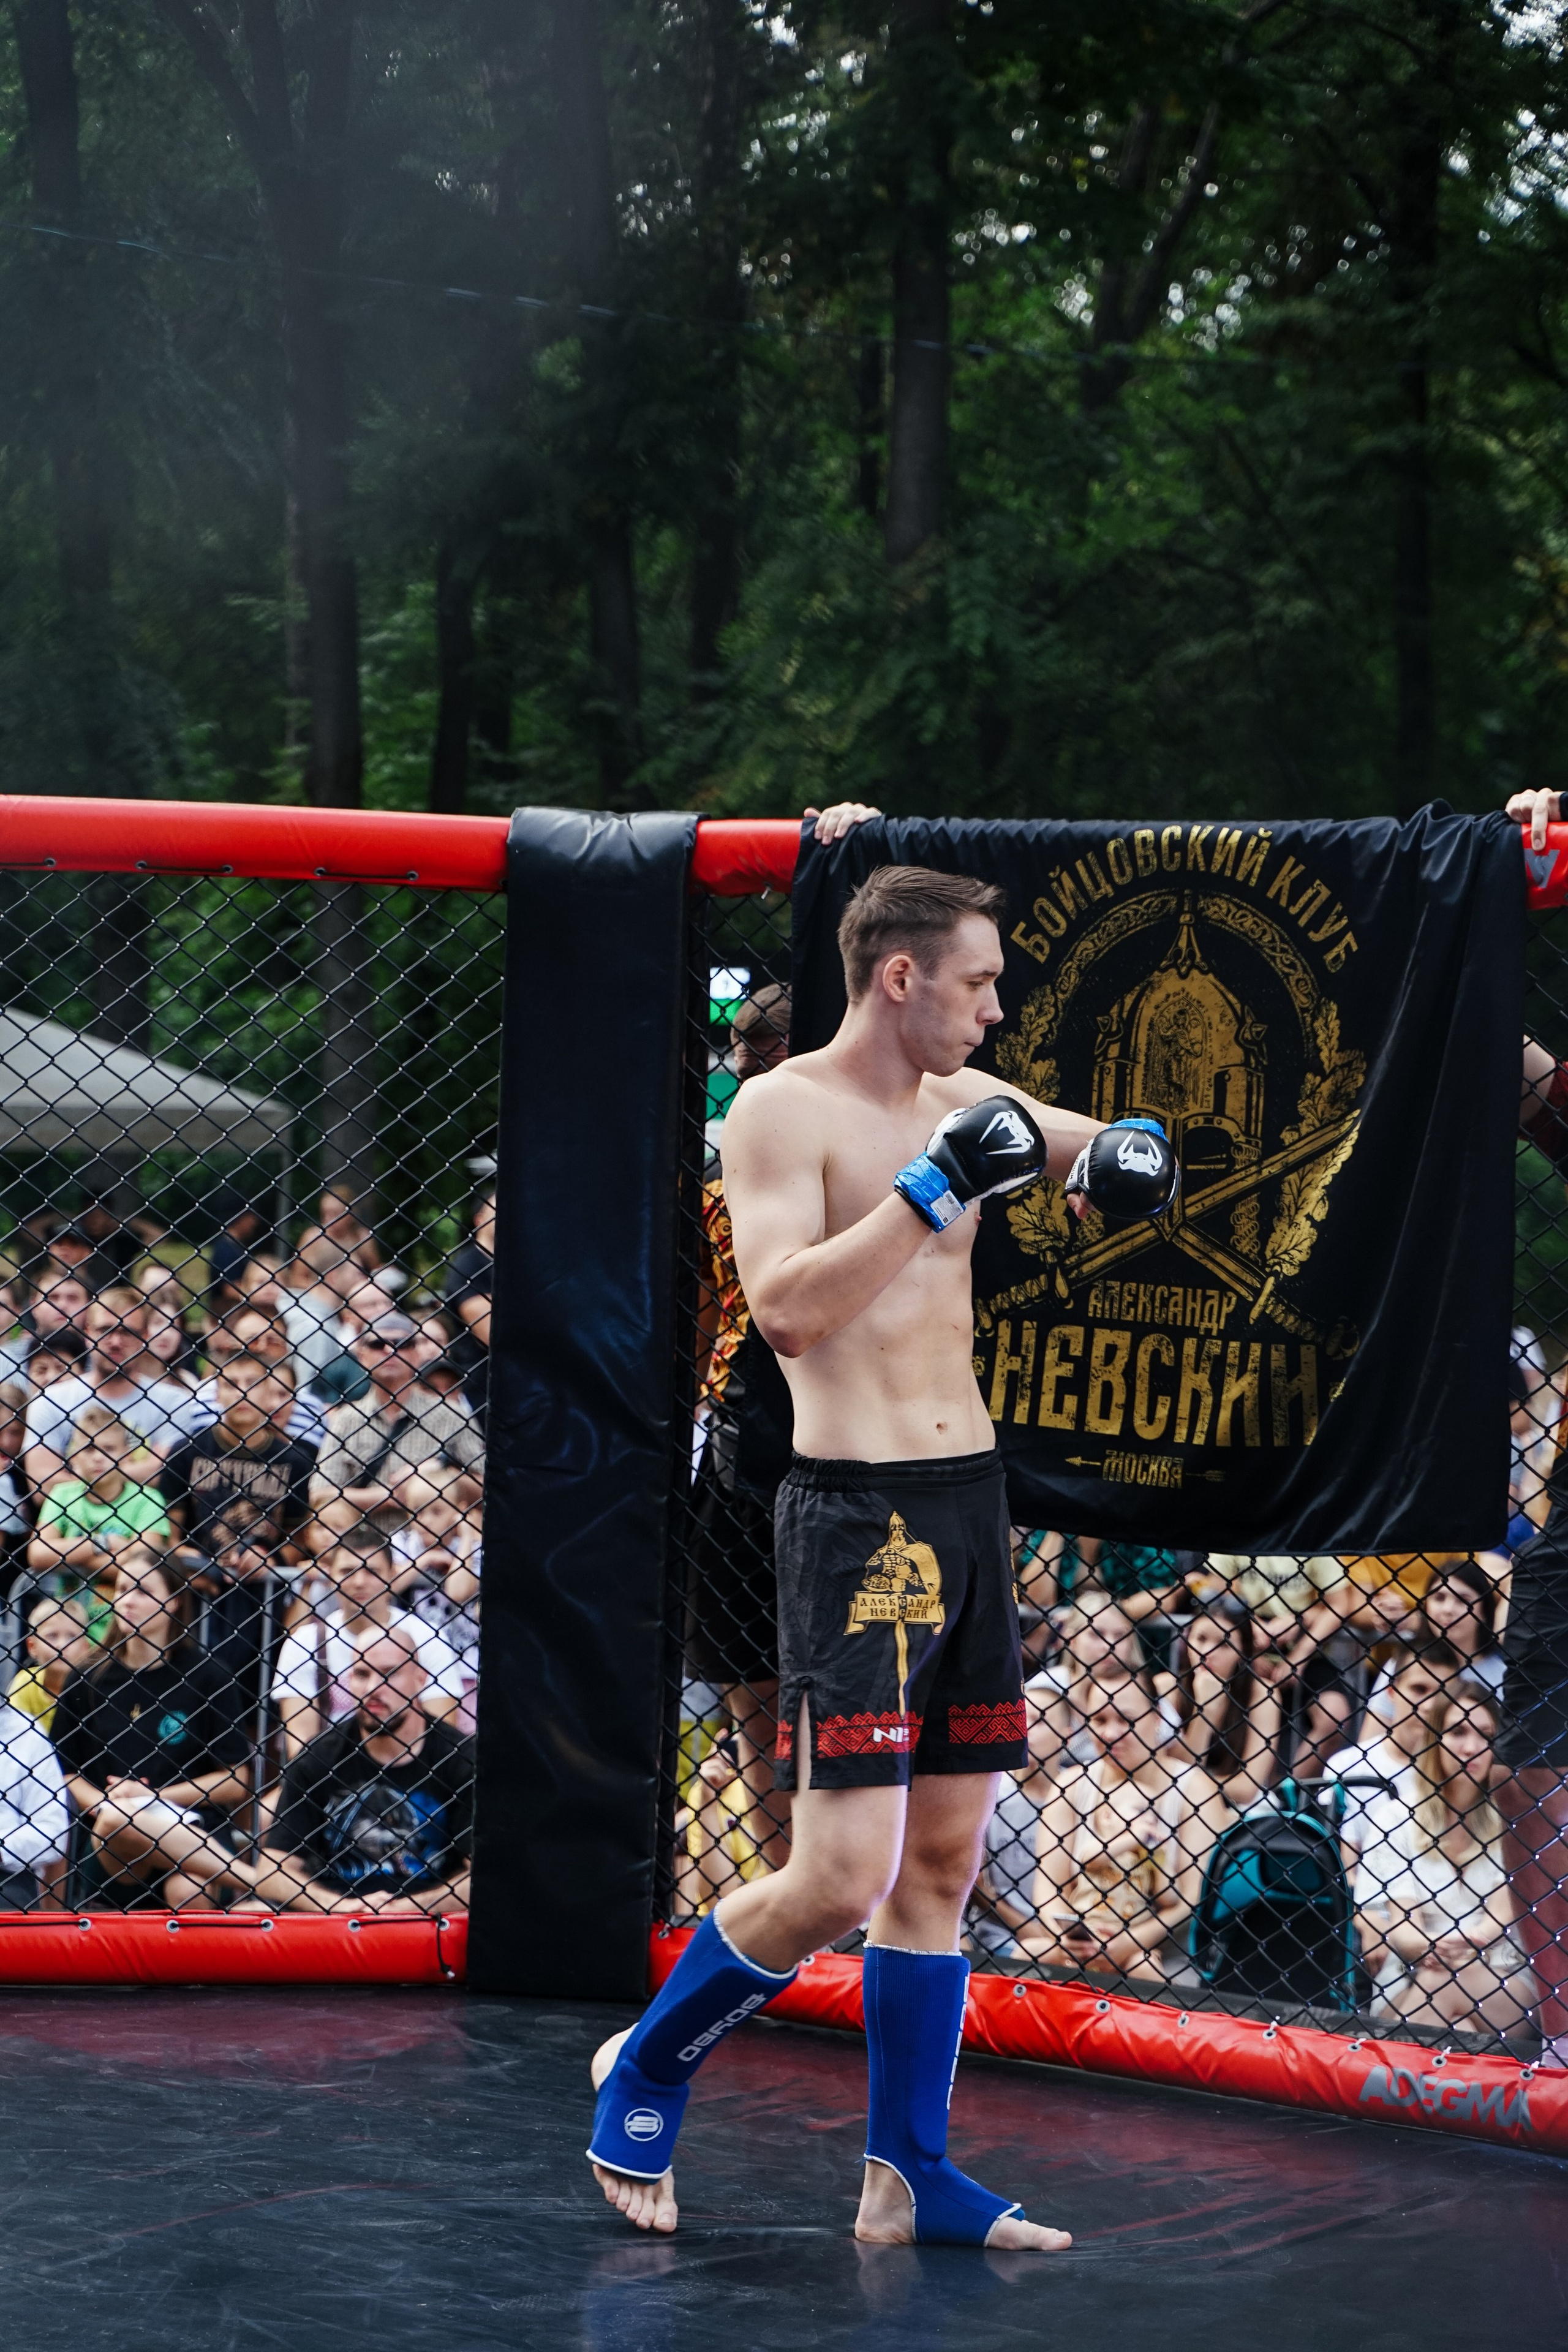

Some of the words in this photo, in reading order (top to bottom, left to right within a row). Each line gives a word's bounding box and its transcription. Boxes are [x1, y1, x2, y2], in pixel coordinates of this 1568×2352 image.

[1010, 824, 1273, 963] БОЙЦОВСКИЙ
[1265, 855, 1359, 973] КЛУБ
[1088, 1280, 1237, 1336] АЛЕКСАНДР
[1102, 1449, 1184, 1489] МОСКВА
[860, 1597, 936, 1608] АЛЕКСАНДР
[870, 1607, 928, 1619] НЕВСКИЙ
[677, 1993, 767, 2061] BOYBO
[1359, 2065, 1532, 2132] ADEGMA
